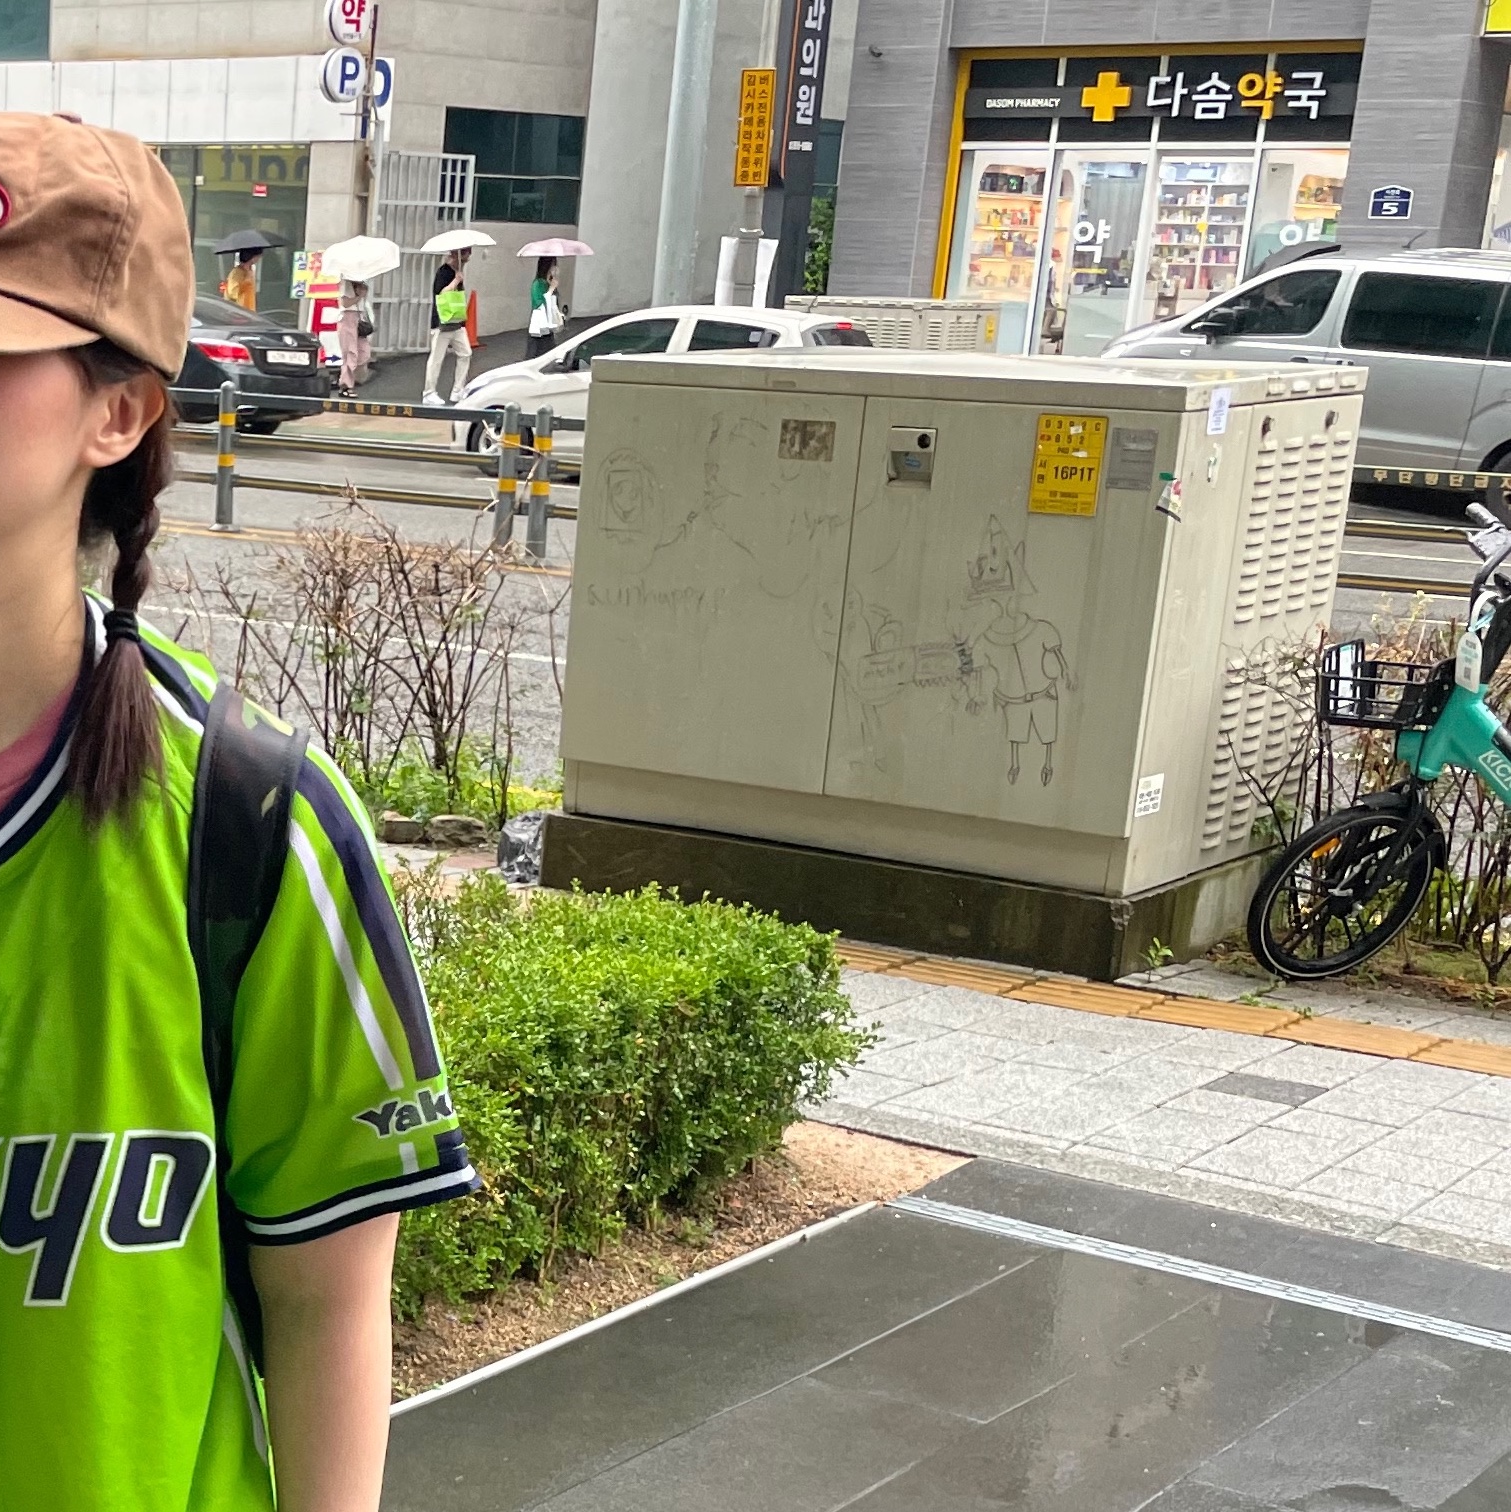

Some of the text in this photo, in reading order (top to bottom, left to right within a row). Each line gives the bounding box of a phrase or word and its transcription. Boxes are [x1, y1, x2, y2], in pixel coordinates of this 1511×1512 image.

[339, 55, 360, 94] P
[986, 98, 1061, 109] DASOM PHARMACY
[1146, 71, 1327, 121] 다솜약국
[1381, 202, 1399, 215] 5
[1073, 219, 1111, 264] 약
[1054, 466, 1095, 482] 16P1T
